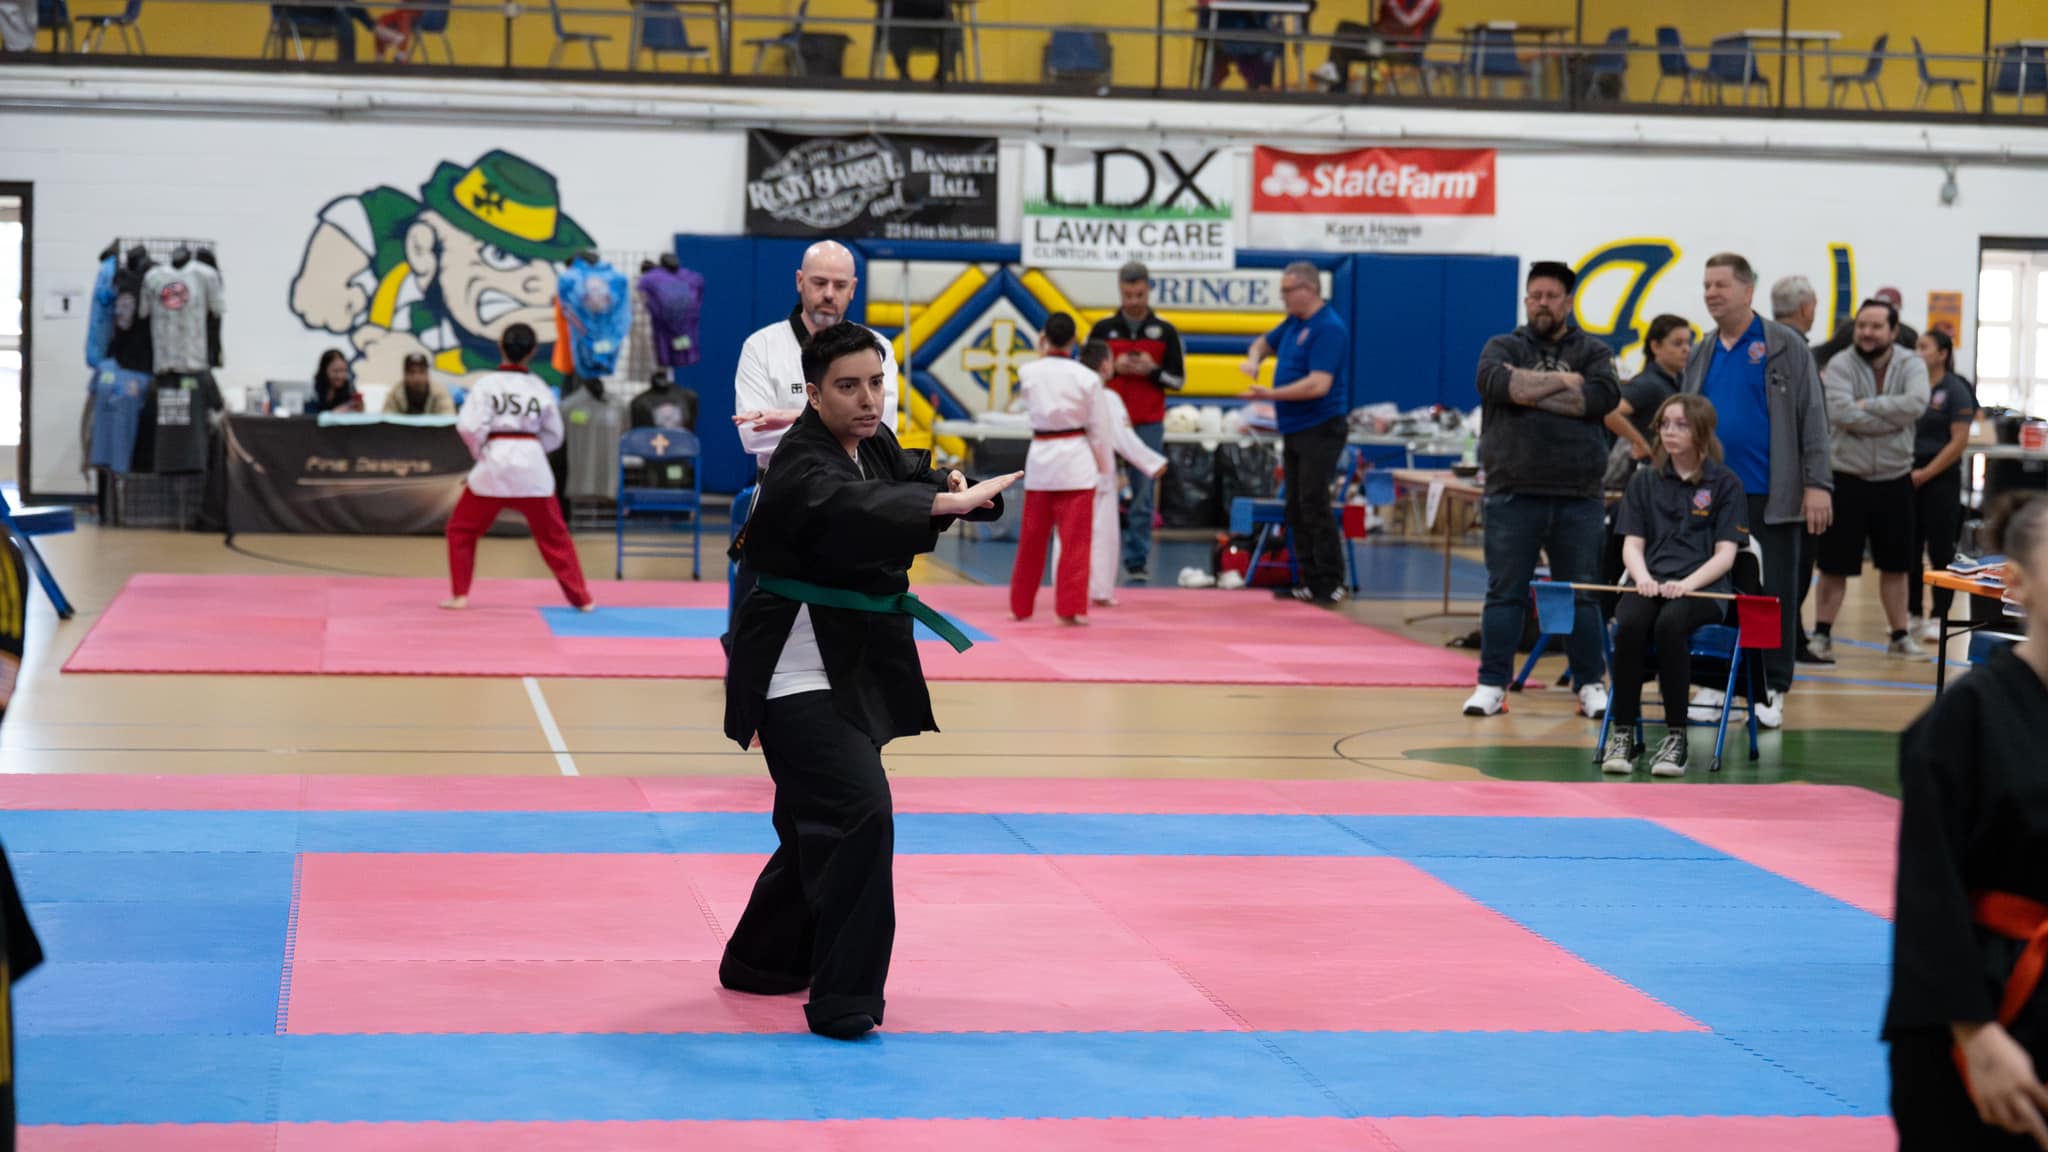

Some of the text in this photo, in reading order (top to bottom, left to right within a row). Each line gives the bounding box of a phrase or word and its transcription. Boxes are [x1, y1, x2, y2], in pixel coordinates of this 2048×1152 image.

[930, 174, 980, 197] HALL
[1042, 146, 1218, 213] LDX
[1035, 219, 1223, 248] LAWN CARE
[491, 392, 541, 417] USA
[355, 456, 432, 477] Designs
